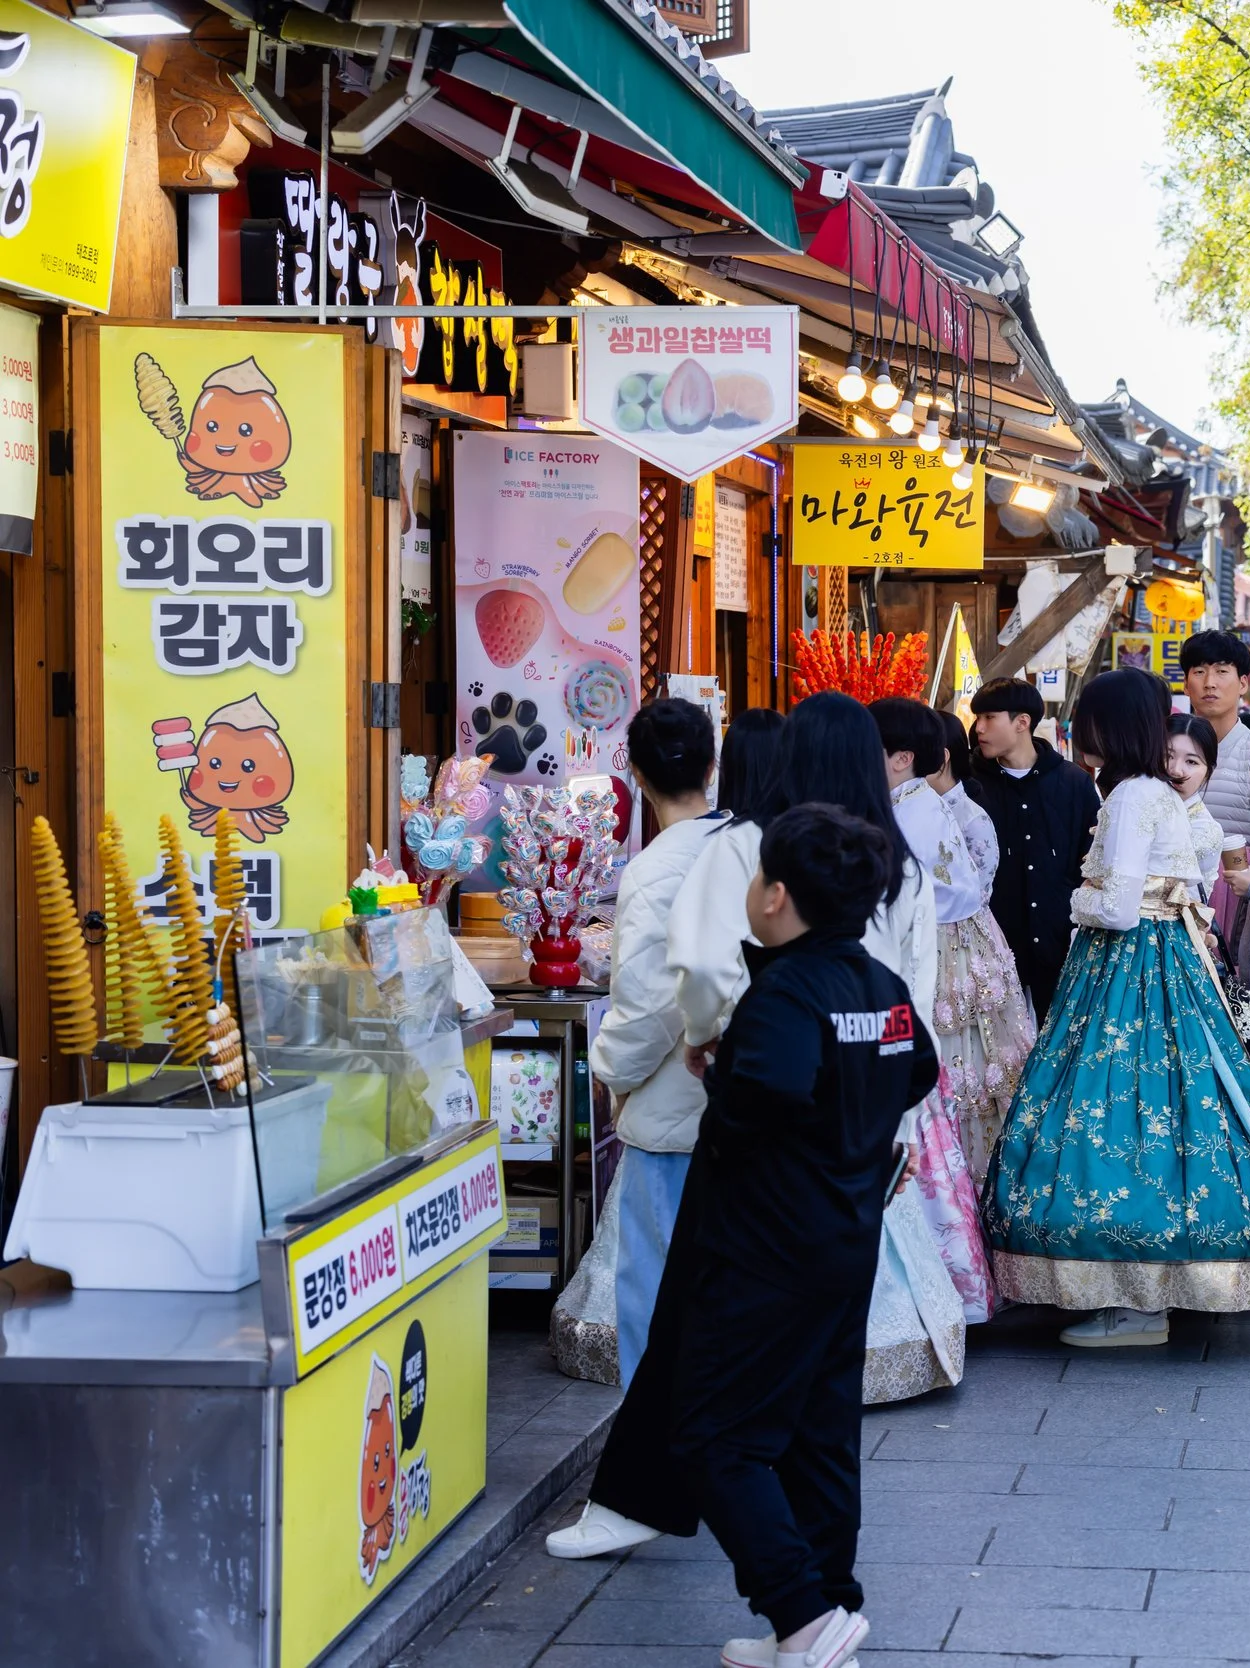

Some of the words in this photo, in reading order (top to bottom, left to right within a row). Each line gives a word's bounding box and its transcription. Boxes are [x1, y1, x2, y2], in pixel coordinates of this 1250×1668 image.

[65, 261, 97, 284] 1899-5892
[608, 326, 772, 354] 생과일찹쌀떡
[4, 441, 35, 466] 3,000원
[515, 450, 534, 462] ICE
[539, 452, 600, 464] FACTORY
[838, 452, 882, 469] 육전의
[887, 450, 908, 470] 왕
[913, 453, 942, 469] 원조
[801, 476, 977, 548] 마왕육전
[123, 521, 324, 587] 회오리
[565, 547, 582, 569] MANGO
[581, 527, 600, 548] SORBET
[873, 551, 904, 565] 2호점
[501, 564, 541, 577] STRAWBERRY
[504, 570, 528, 578] SORBET
[159, 603, 295, 667] 감자
[593, 639, 623, 655] RAINBOW
[623, 649, 634, 663] POP
[405, 1184, 461, 1258] 치즈문강정
[461, 1163, 499, 1224] 8,000원
[303, 1254, 347, 1329] 문강정
[349, 1224, 397, 1298] 6,000원
